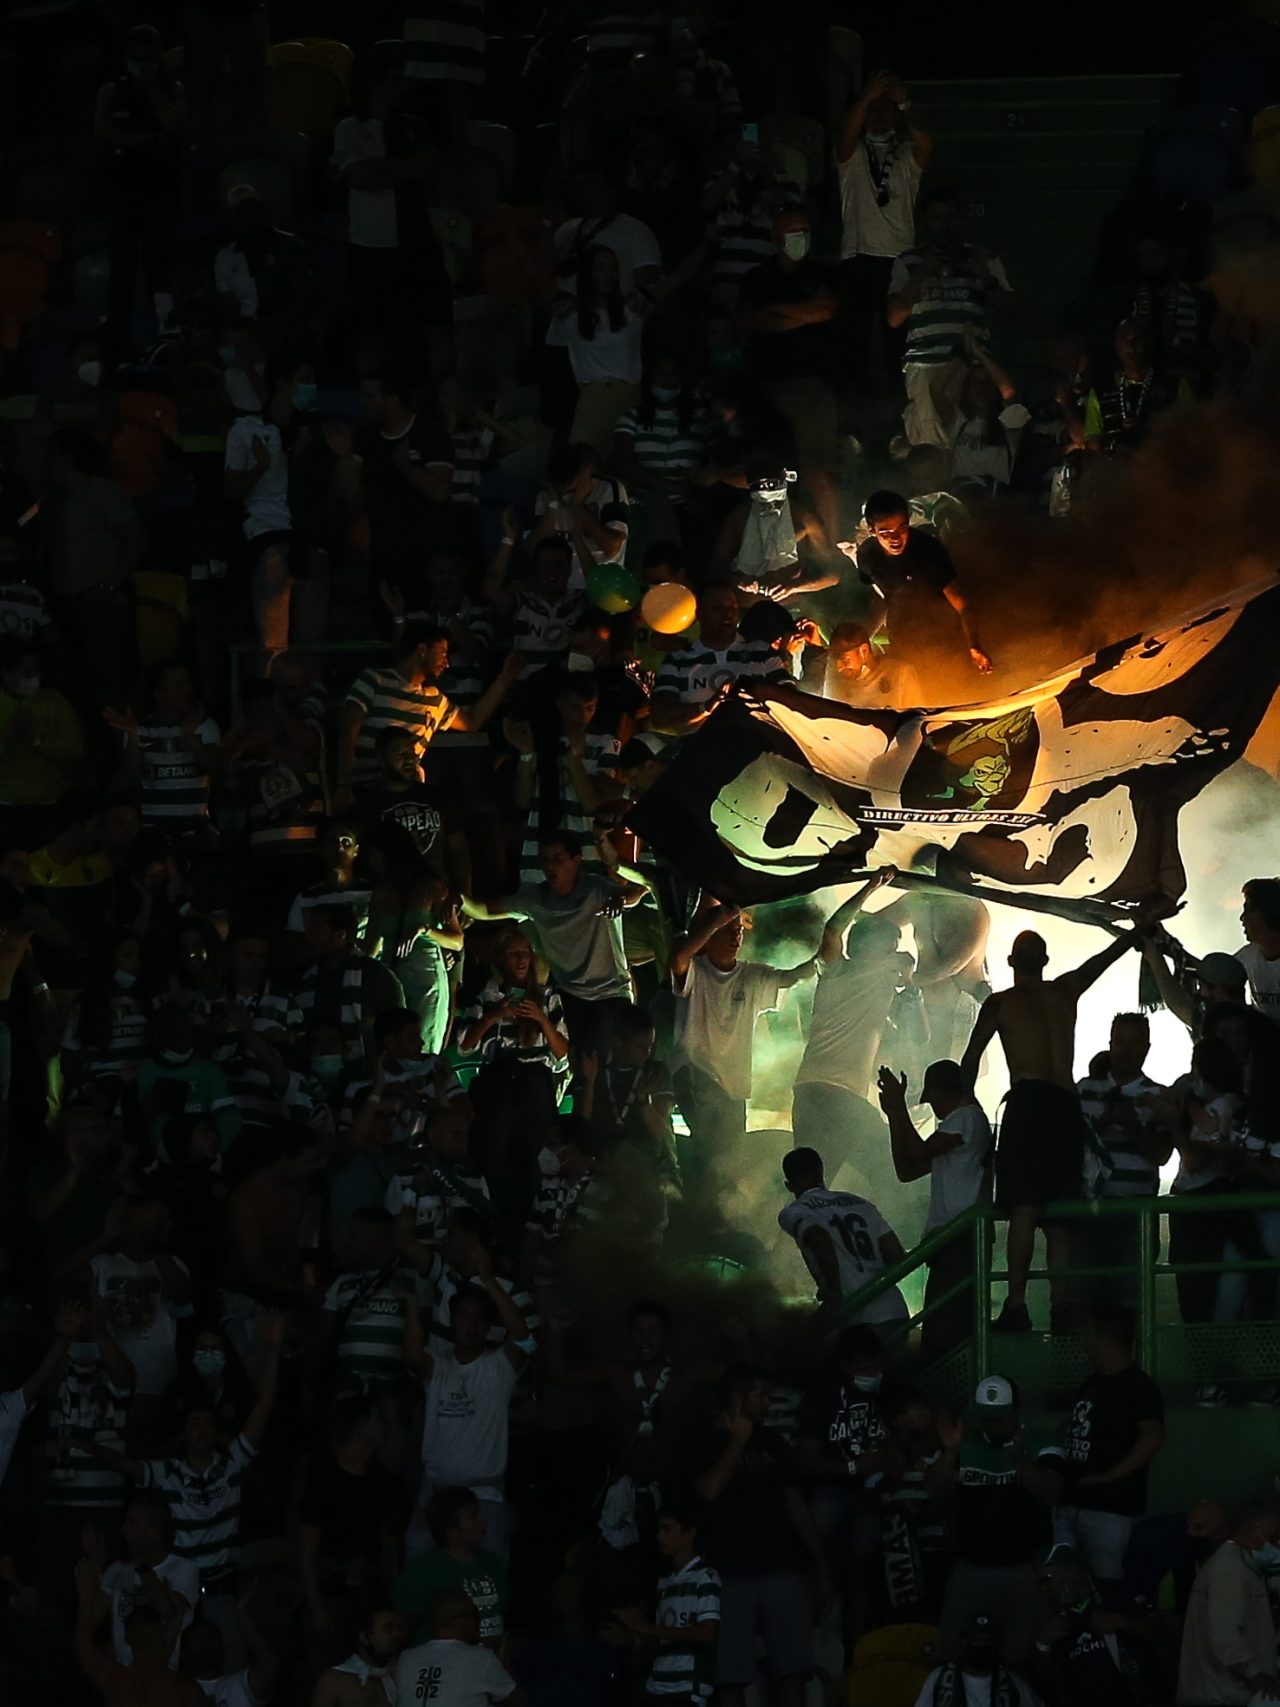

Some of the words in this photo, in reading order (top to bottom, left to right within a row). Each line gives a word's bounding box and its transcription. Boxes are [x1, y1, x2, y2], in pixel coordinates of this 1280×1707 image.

[1007, 112, 1024, 128] 21
[967, 202, 985, 217] 20
[0, 608, 32, 630] OS
[529, 622, 562, 642] NO
[693, 670, 736, 690] NO
[157, 767, 193, 778] BETAN
[863, 810, 950, 823] DIRECTIVO
[952, 812, 1006, 823] ULTRAS
[828, 1213, 876, 1266] 16
[963, 1469, 1018, 1485] SPORTIN
